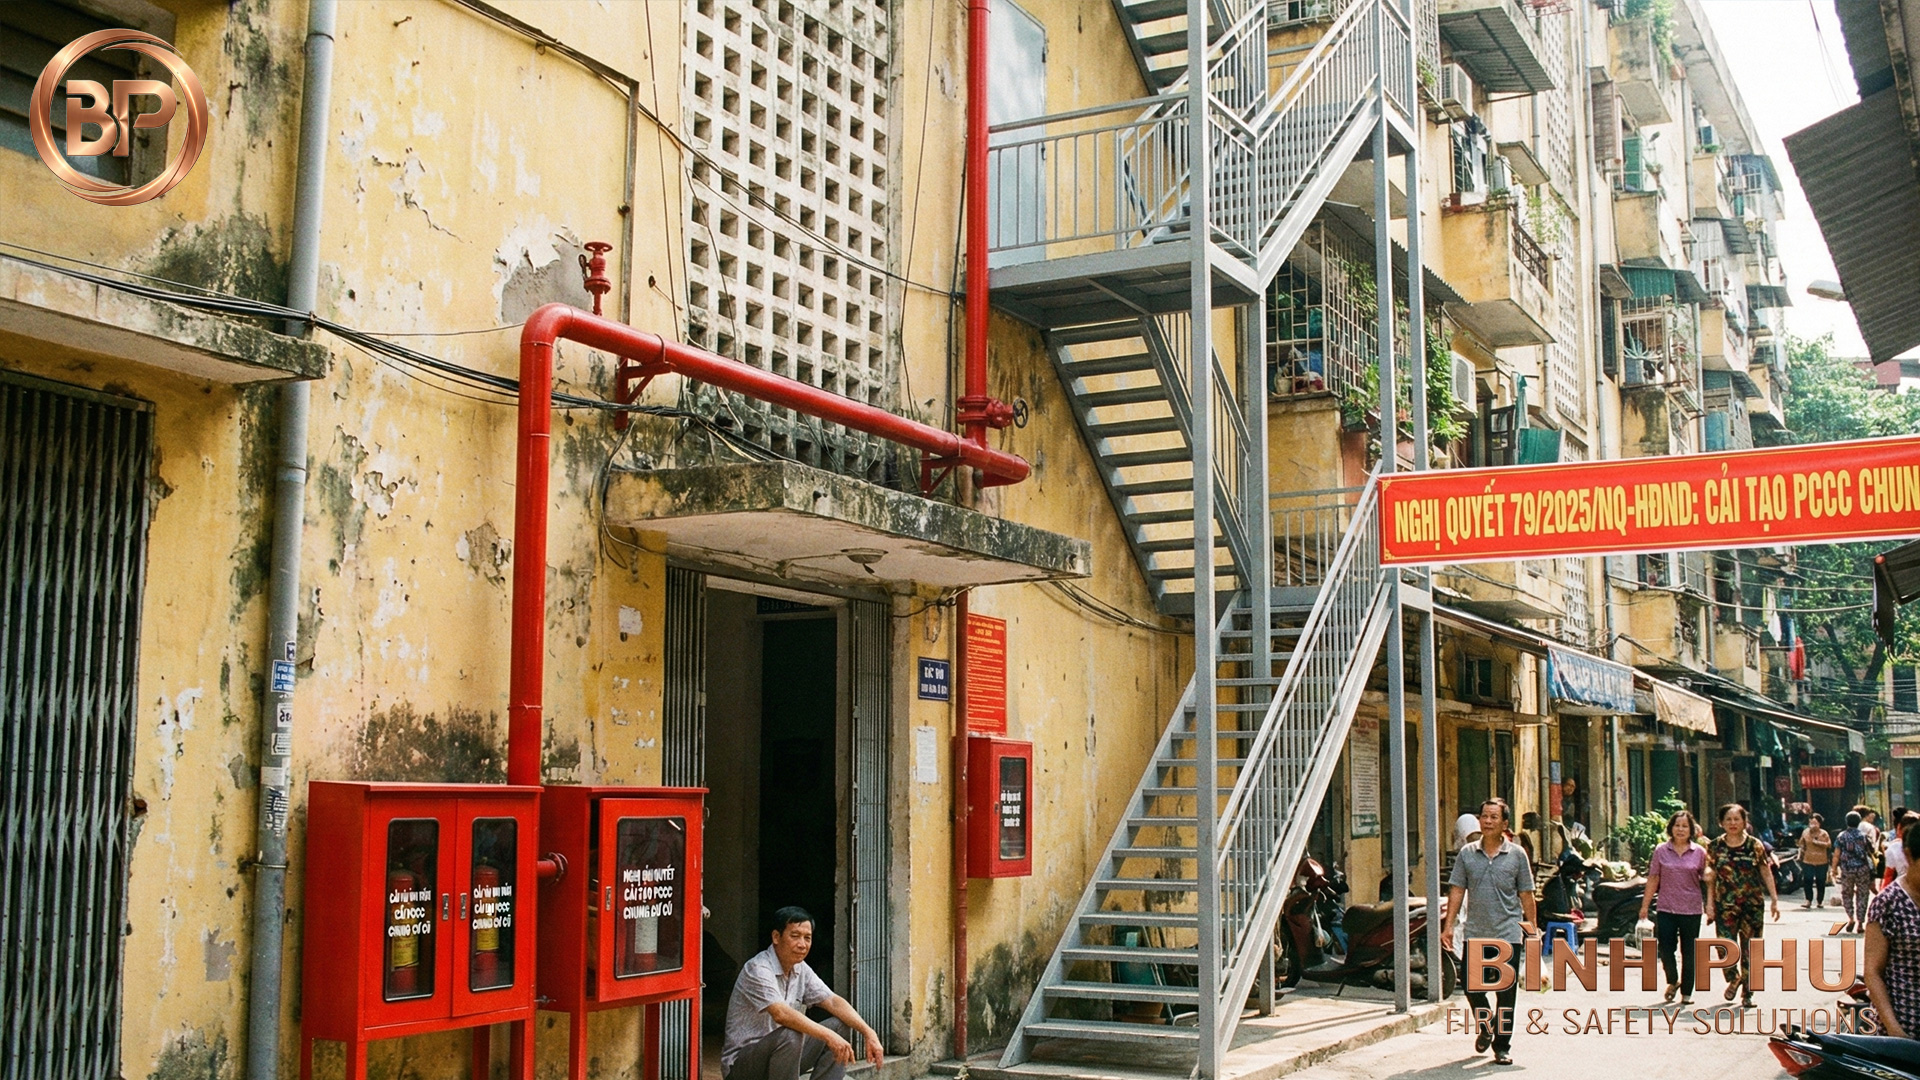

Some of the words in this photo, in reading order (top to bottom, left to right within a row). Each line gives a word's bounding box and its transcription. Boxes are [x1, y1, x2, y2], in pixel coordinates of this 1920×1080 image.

[1394, 498, 1441, 551] NGHỊ
[1445, 478, 1506, 546] QUYẾT
[1510, 480, 1699, 537] 79/2025/NQ-HĐND:
[1704, 461, 1741, 526] CẢI
[1745, 474, 1788, 532] TẠO
[1793, 469, 1852, 519] PCCC
